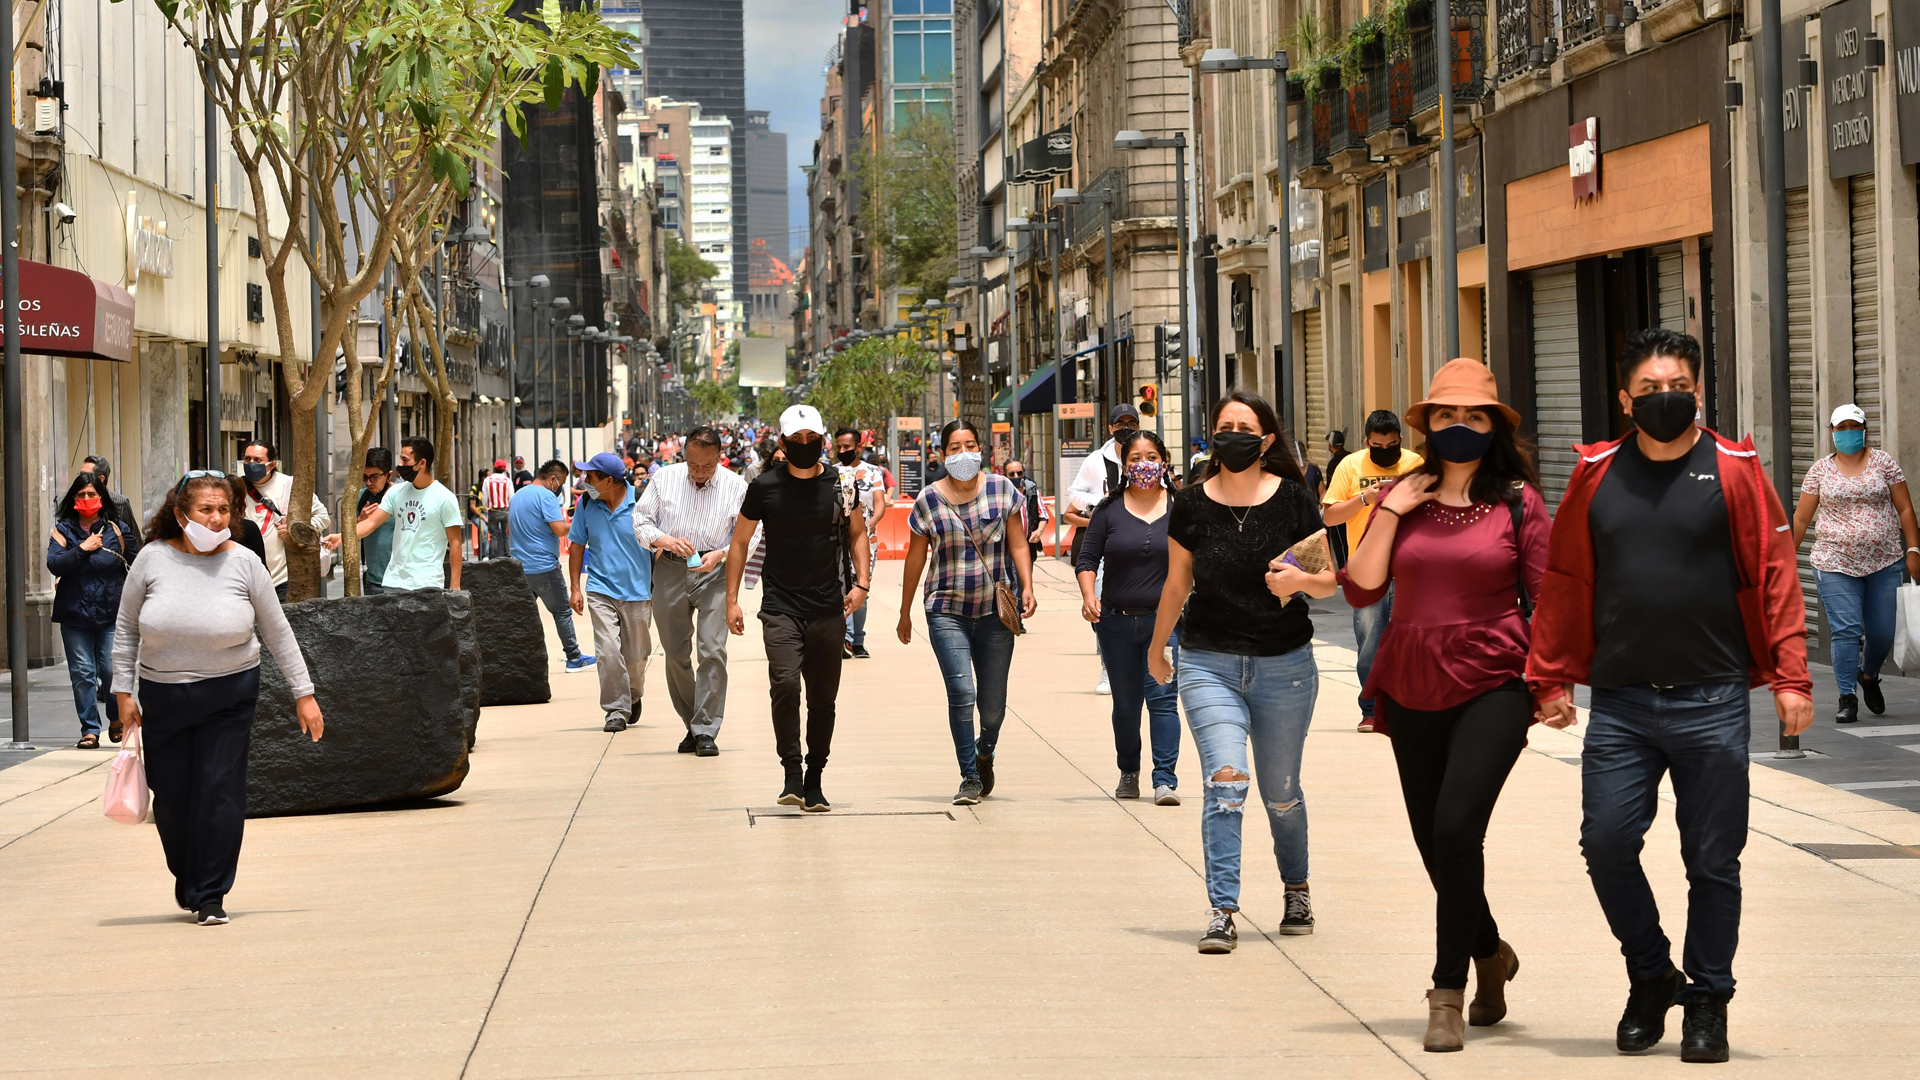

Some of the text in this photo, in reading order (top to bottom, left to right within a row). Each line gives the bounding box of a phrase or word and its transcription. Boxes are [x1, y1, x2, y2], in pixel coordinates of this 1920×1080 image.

[1835, 27, 1859, 58] MUSEO
[1832, 112, 1871, 150] DEL DISEÑO
[405, 500, 419, 508] POLO
